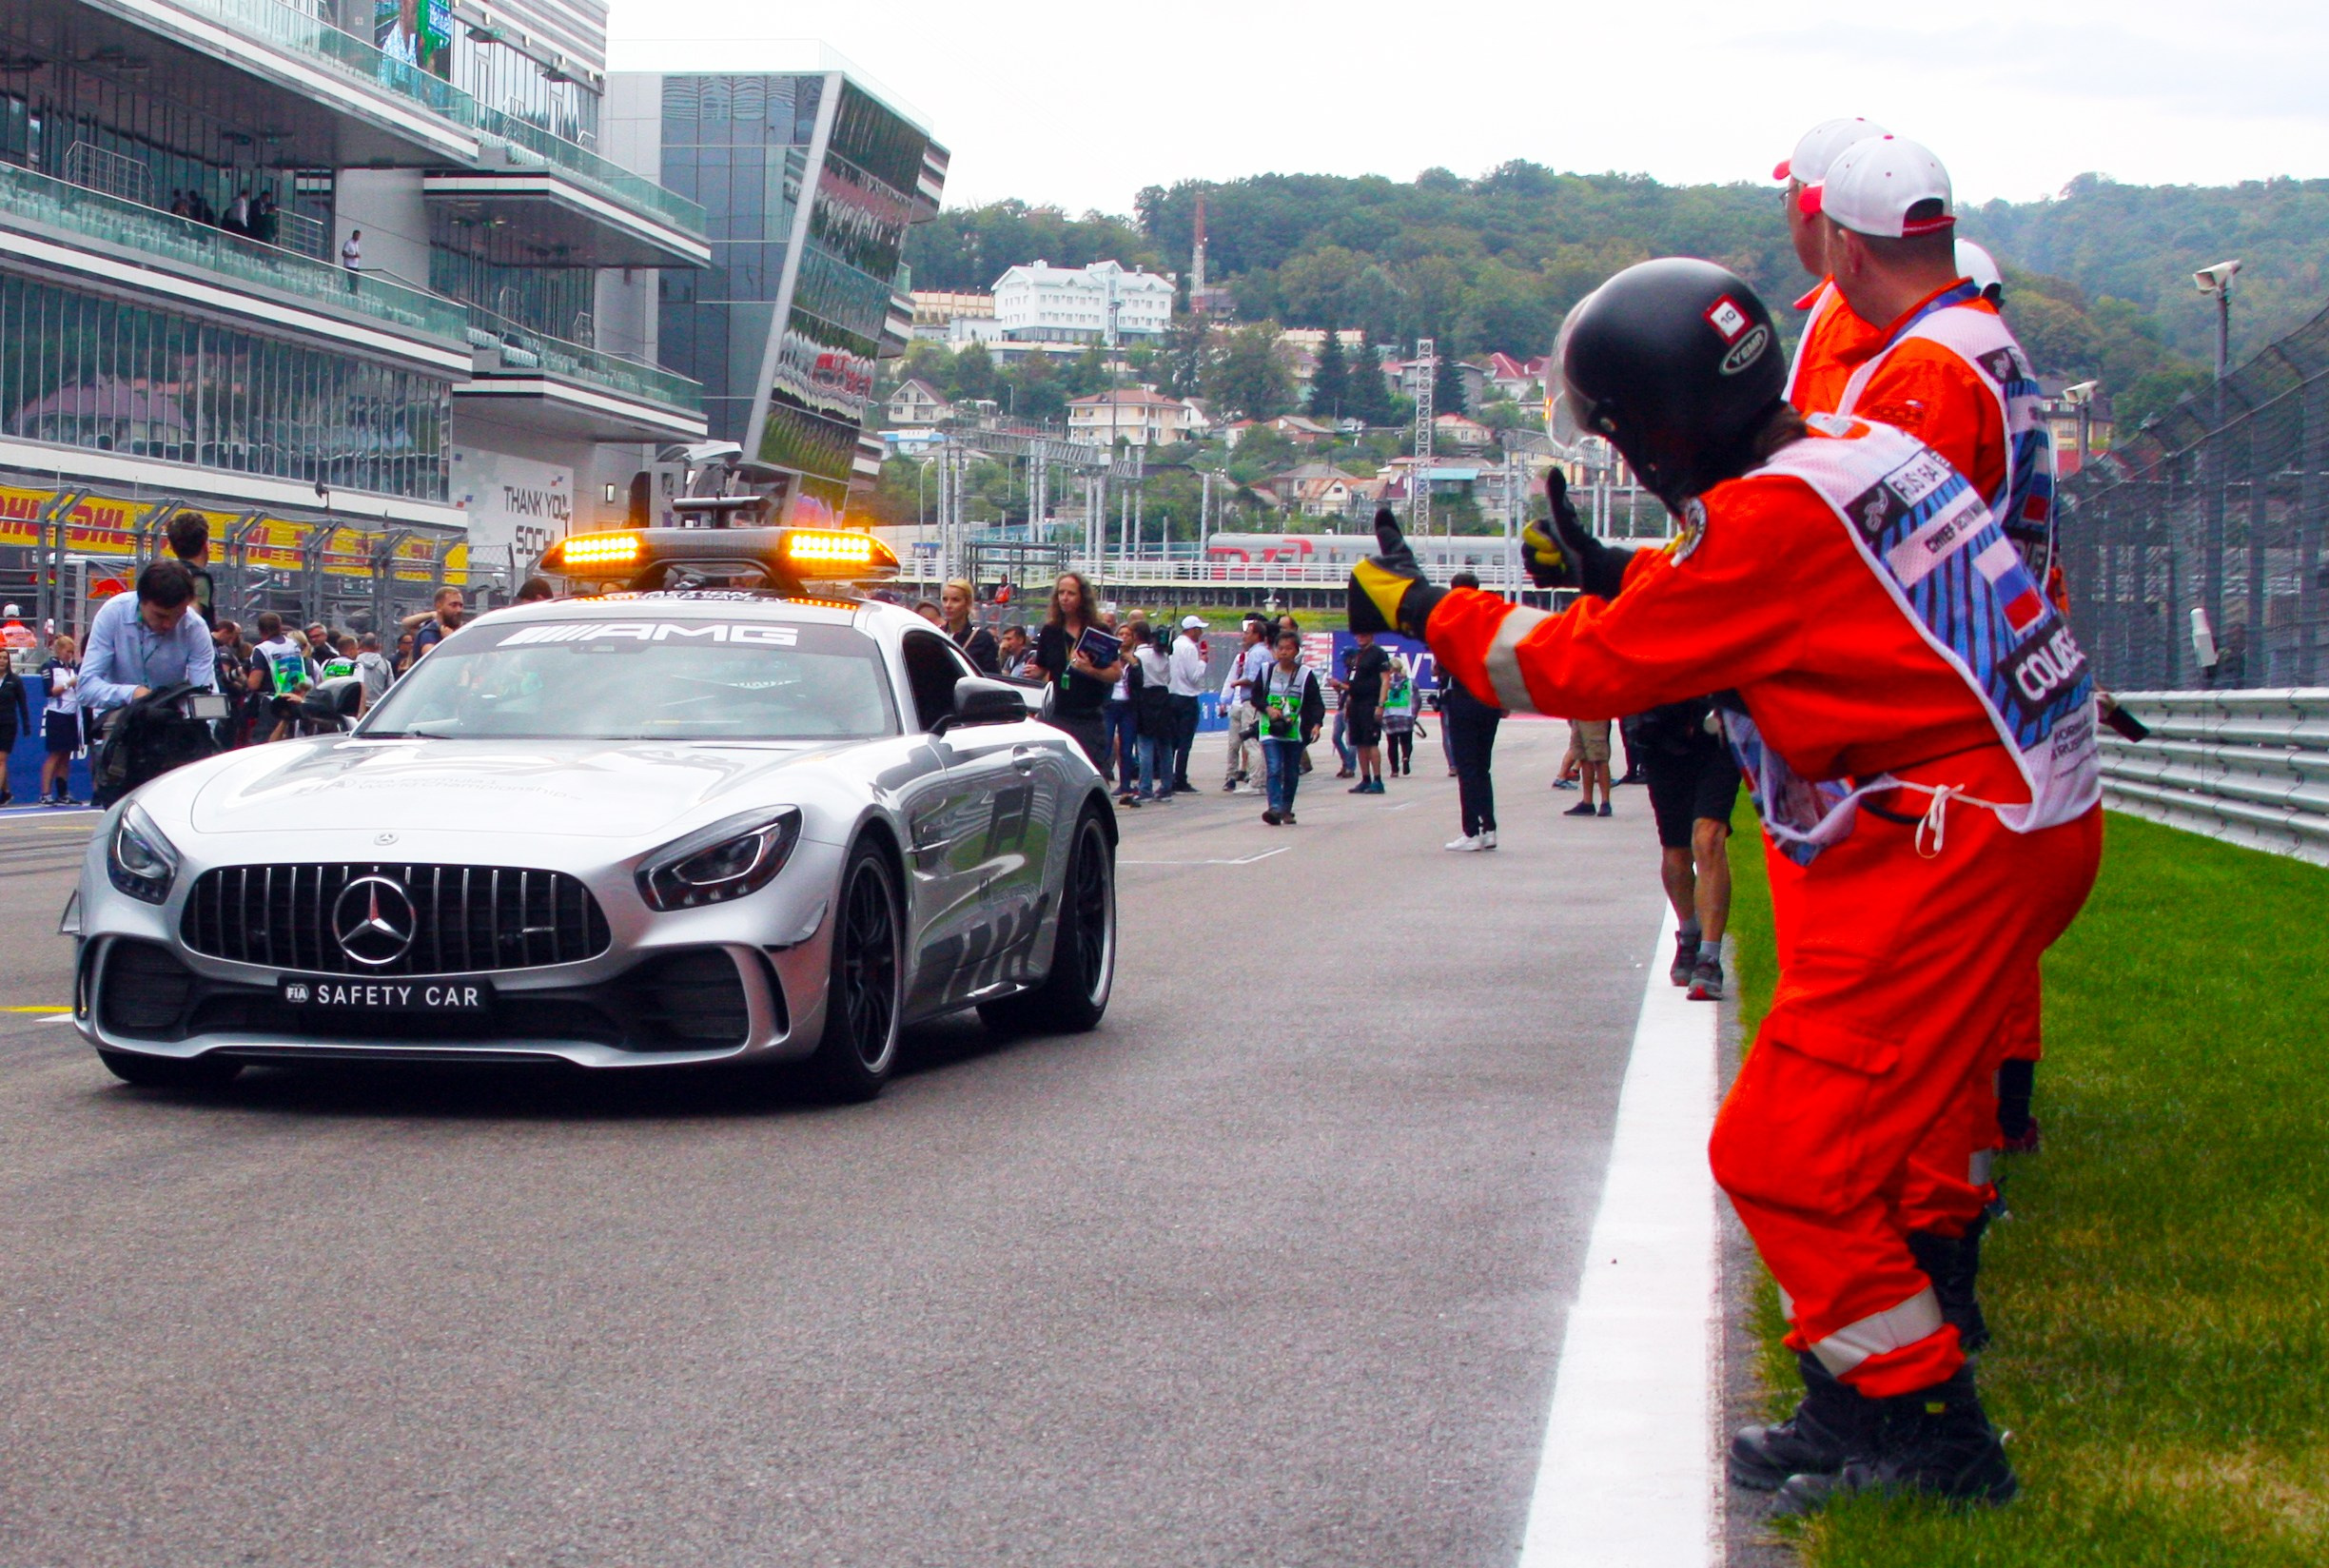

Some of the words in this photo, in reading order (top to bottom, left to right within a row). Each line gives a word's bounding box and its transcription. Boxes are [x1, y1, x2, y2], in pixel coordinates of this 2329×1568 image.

[1720, 309, 1736, 324] 10
[0, 495, 45, 536] HL
[503, 485, 543, 517] THANK
[545, 492, 570, 520] YOU
[70, 503, 127, 545] DHL
[516, 525, 555, 557] SOCHI
[577, 623, 798, 646] AMG
[286, 986, 308, 1001] FIA
[318, 985, 412, 1006] SAFETY
[425, 986, 479, 1008] CAR
